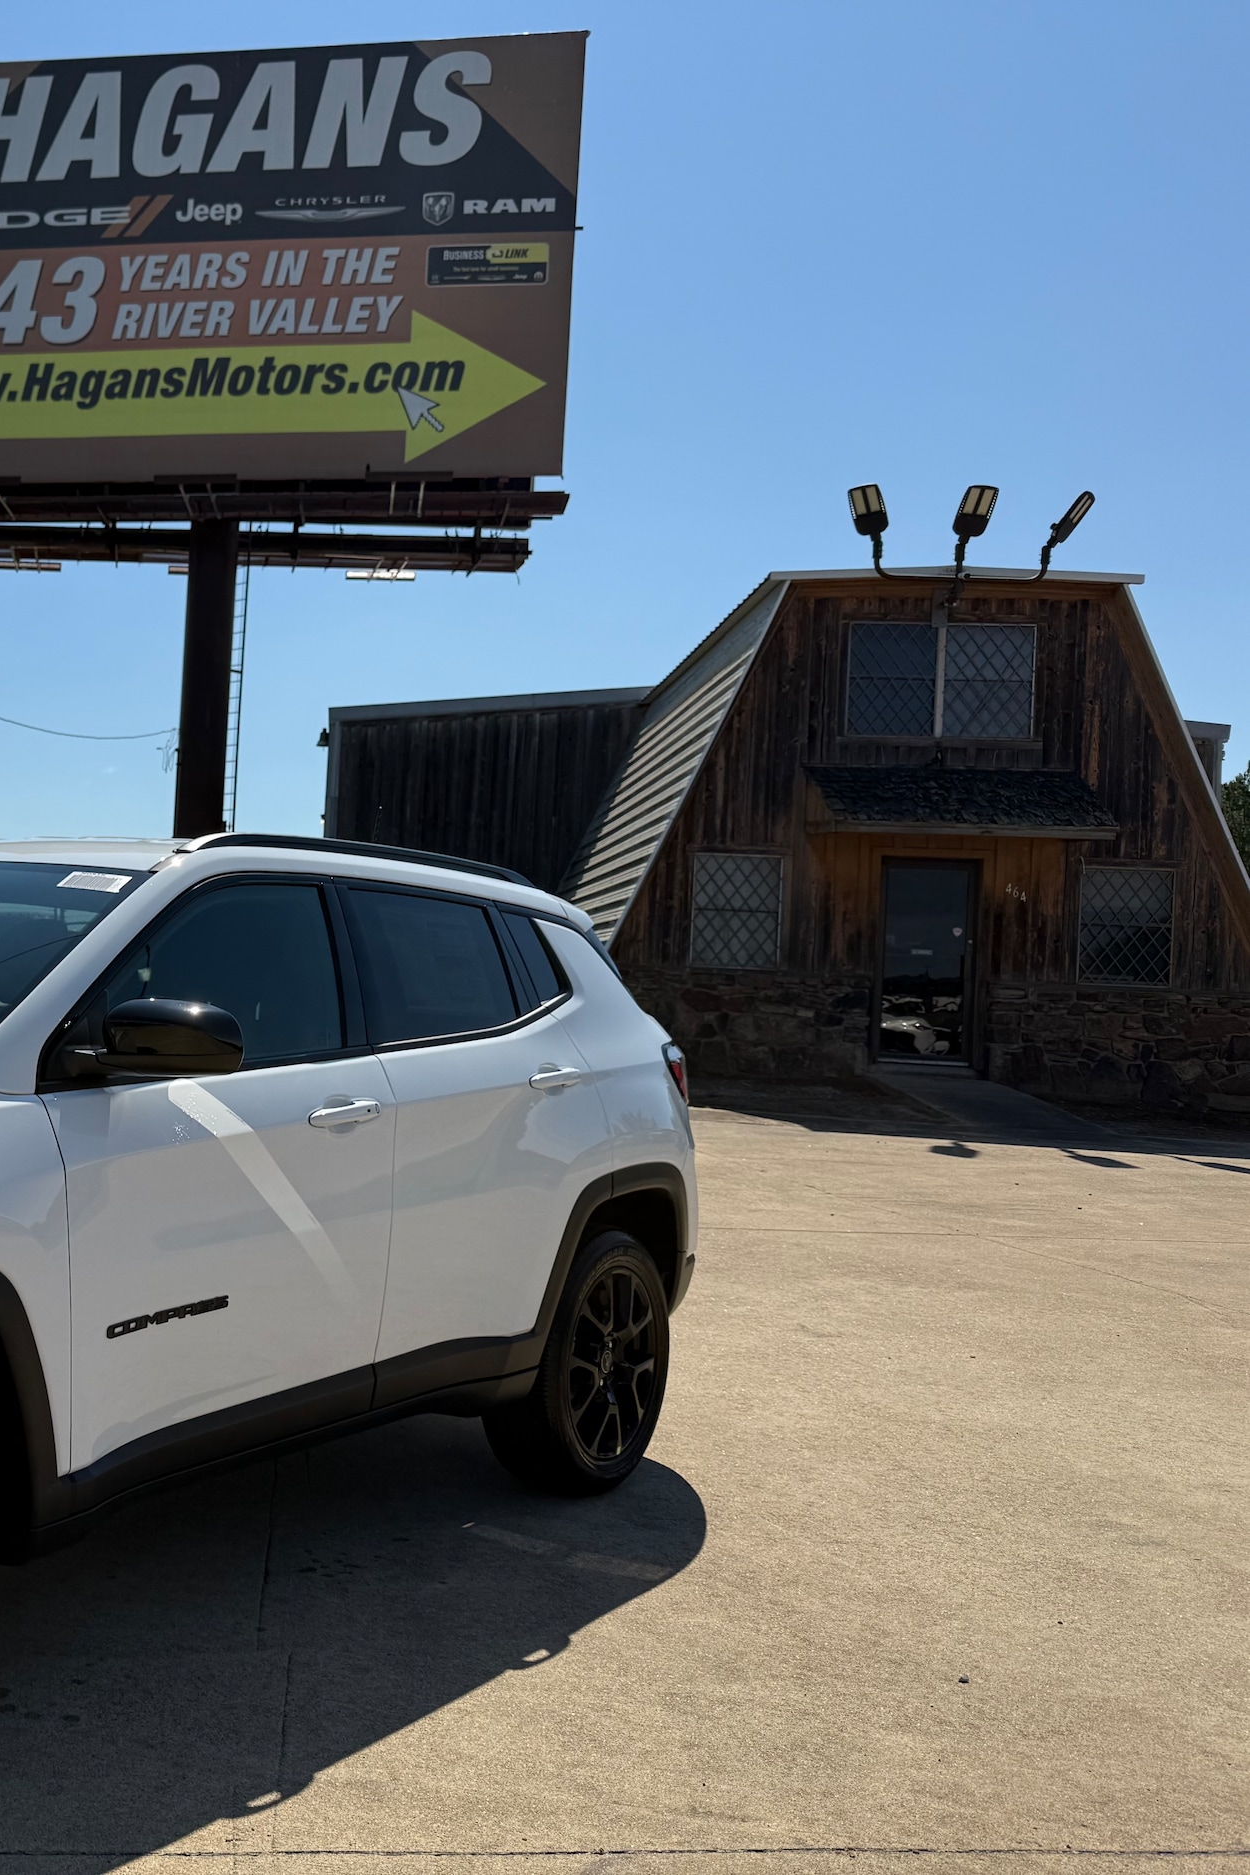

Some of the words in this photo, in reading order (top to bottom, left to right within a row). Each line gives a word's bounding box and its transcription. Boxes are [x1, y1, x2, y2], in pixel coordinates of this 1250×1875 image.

[175, 199, 243, 225] Jeep
[275, 195, 387, 207] CHRYSLER
[463, 198, 556, 215] RAM
[443, 249, 485, 261] BUSINESS
[505, 248, 530, 259] LINK
[119, 250, 250, 292] YEARS
[261, 249, 314, 288] IN
[322, 247, 401, 286] THE
[112, 300, 235, 341] RIVER
[248, 295, 405, 336] VALLEY
[1005, 882, 1027, 903] 464
[106, 1295, 229, 1339] COMPASS
